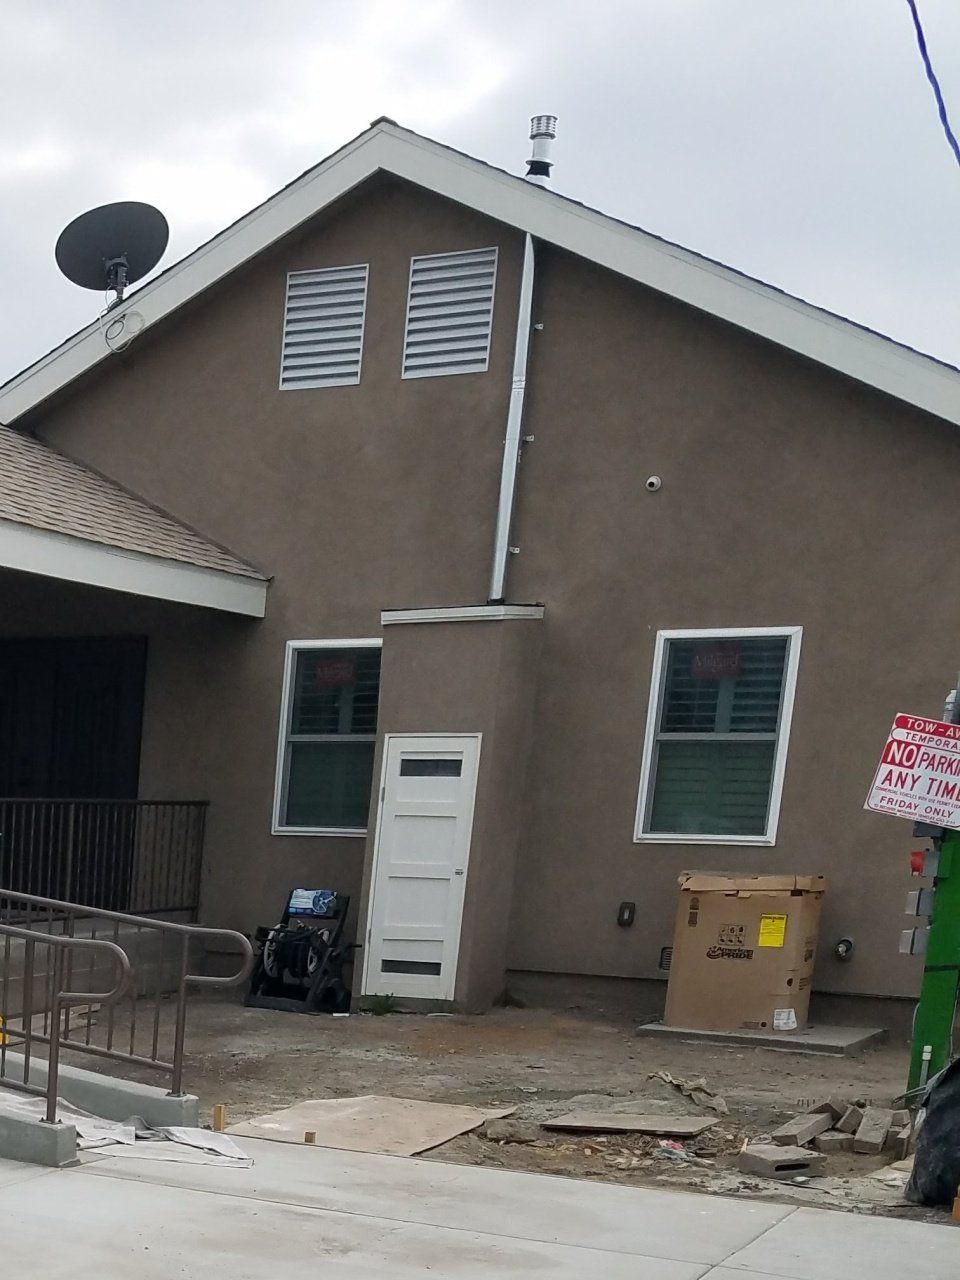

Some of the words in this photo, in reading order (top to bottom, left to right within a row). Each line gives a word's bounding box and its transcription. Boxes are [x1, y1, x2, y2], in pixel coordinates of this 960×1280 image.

[905, 731, 960, 751] TEMPORA
[886, 741, 918, 767] NO
[917, 751, 960, 777] PARKI
[881, 768, 922, 792] ANY
[880, 795, 920, 811] FRIDAY
[924, 806, 954, 819] ONLY
[720, 952, 753, 960] PRIDE
